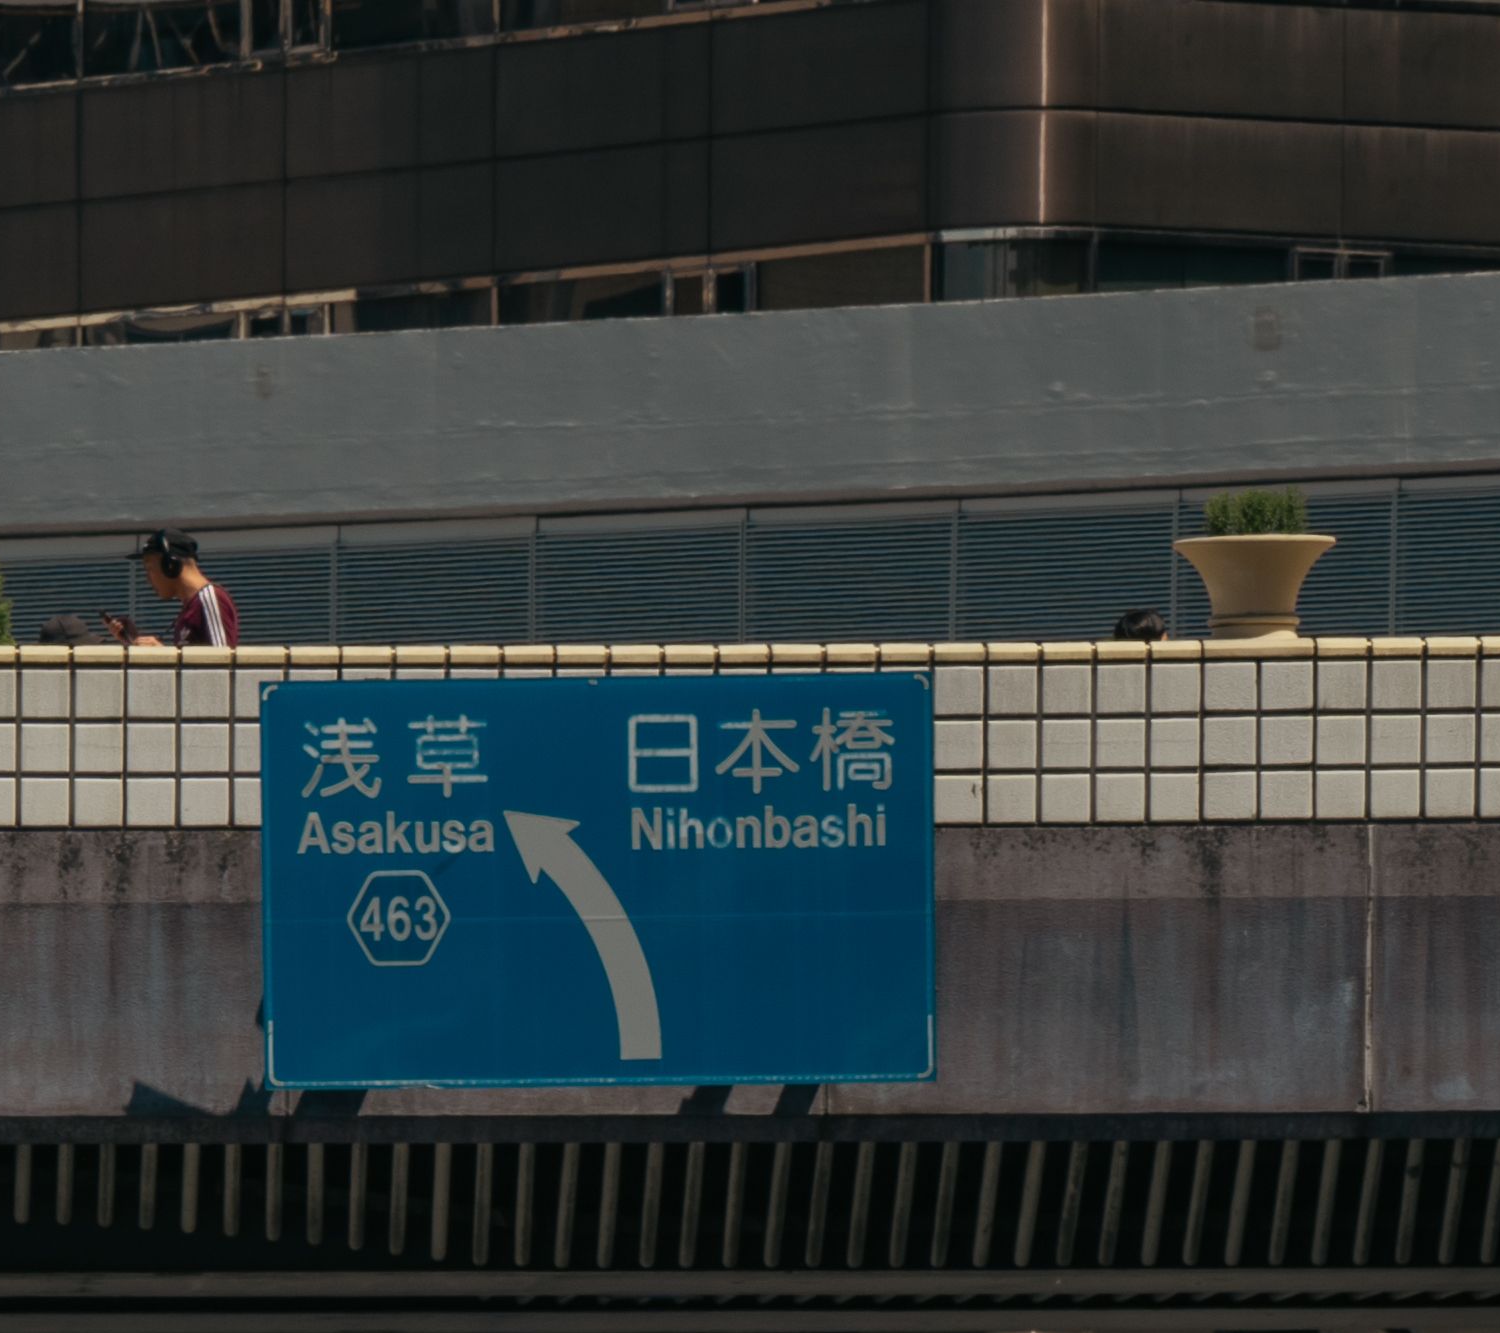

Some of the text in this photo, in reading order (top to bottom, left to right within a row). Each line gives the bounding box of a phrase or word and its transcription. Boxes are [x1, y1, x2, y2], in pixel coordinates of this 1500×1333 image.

[301, 706, 896, 798] 浅草 日本橋
[298, 803, 888, 855] Asakusa Nihonbashi
[359, 896, 439, 944] 463
